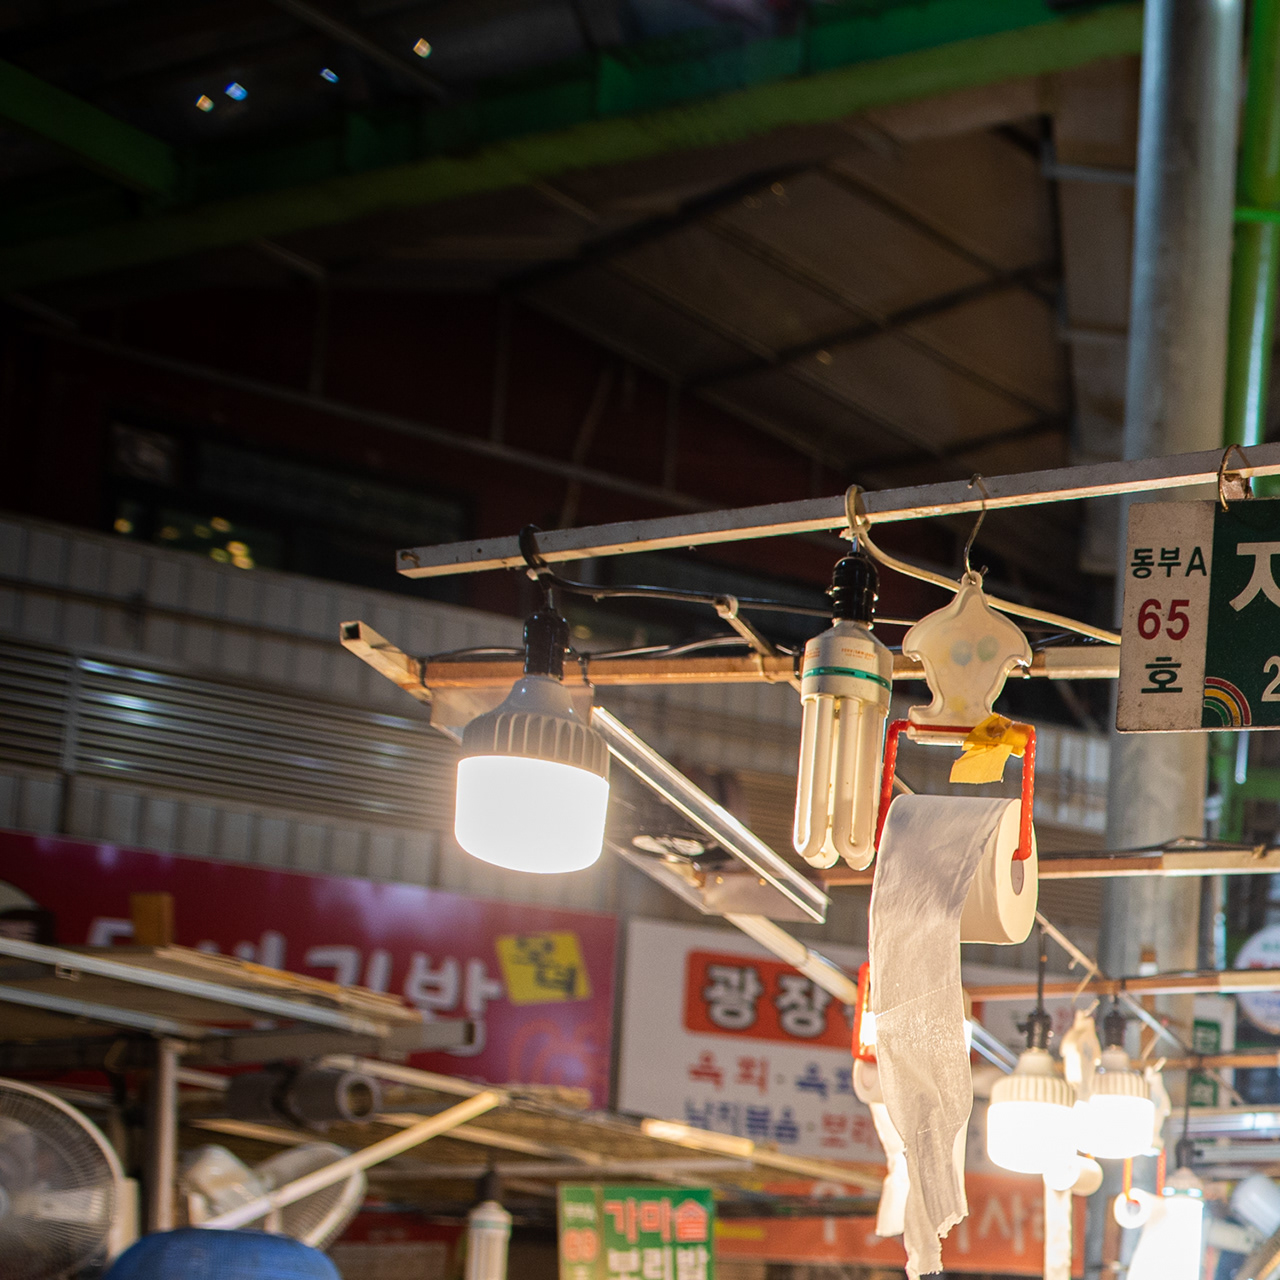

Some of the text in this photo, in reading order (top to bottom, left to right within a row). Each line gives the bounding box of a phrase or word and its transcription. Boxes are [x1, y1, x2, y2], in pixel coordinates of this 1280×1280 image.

[1130, 546, 1207, 579] 동부A
[1137, 599, 1190, 641] 65
[1141, 656, 1183, 694] 호
